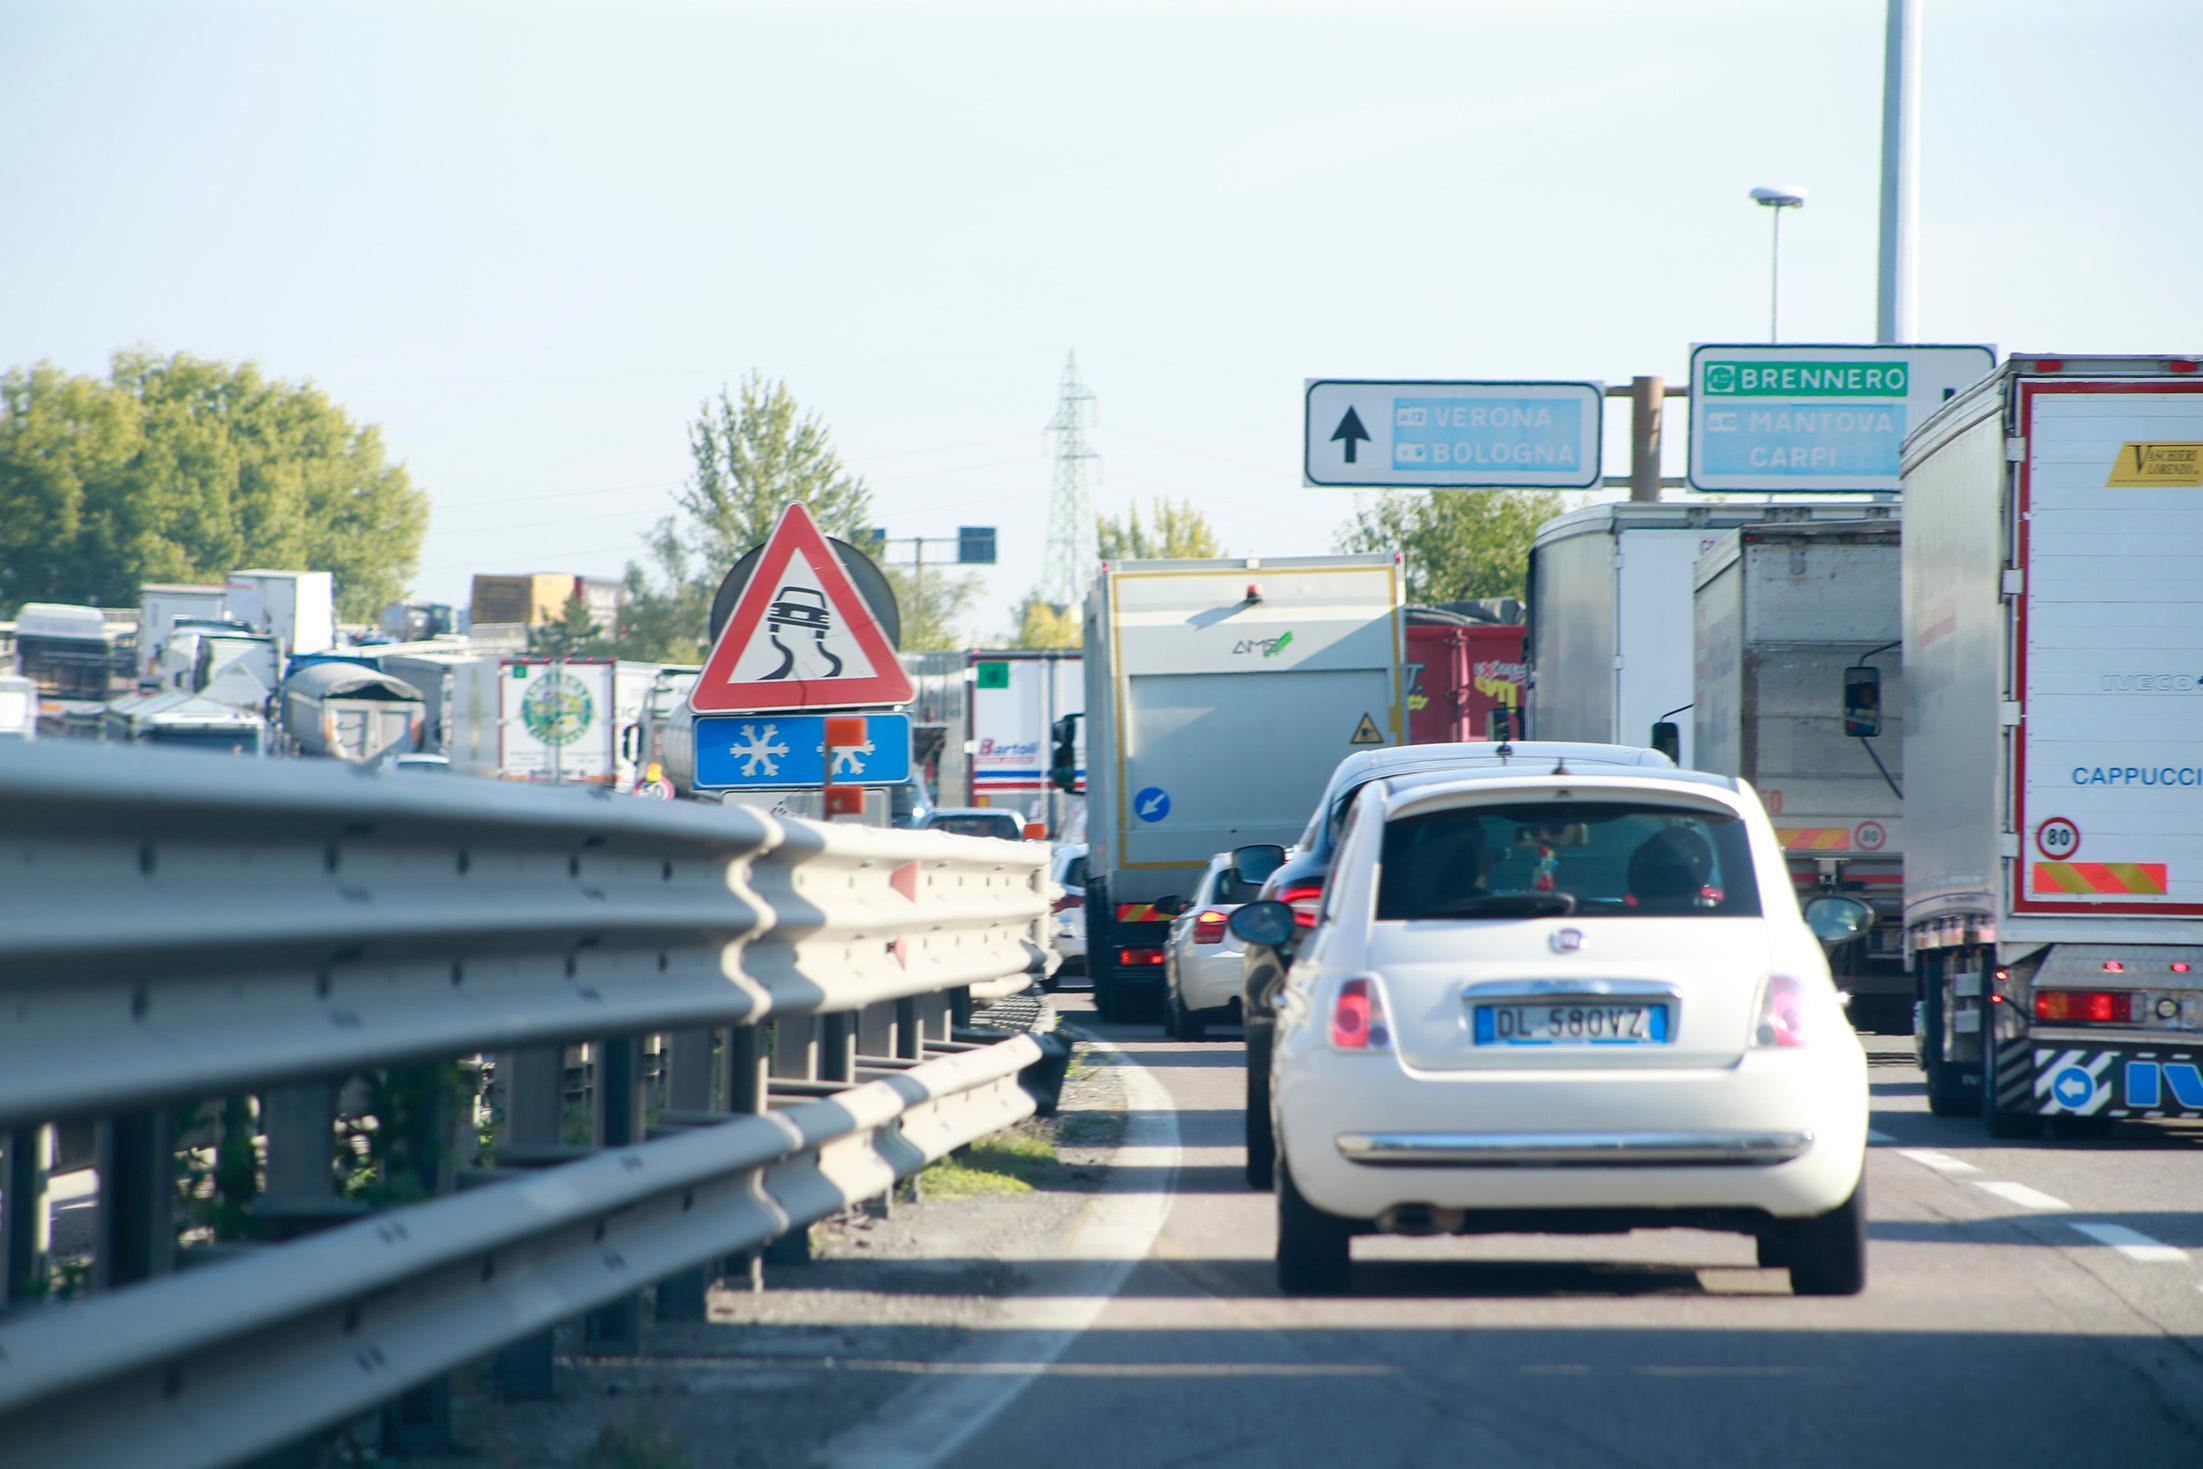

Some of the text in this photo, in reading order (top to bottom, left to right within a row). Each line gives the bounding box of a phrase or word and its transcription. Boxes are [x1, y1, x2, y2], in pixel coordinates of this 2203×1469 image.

[1741, 368, 1905, 390] BRENNERO
[1434, 406, 1552, 428] VERONA
[1749, 410, 1895, 434] MANTOVA
[1433, 441, 1575, 465] BOLOGNA
[1750, 446, 1838, 469] CARPI
[2047, 828, 2070, 846] 80
[1499, 1009, 1532, 1037] DL
